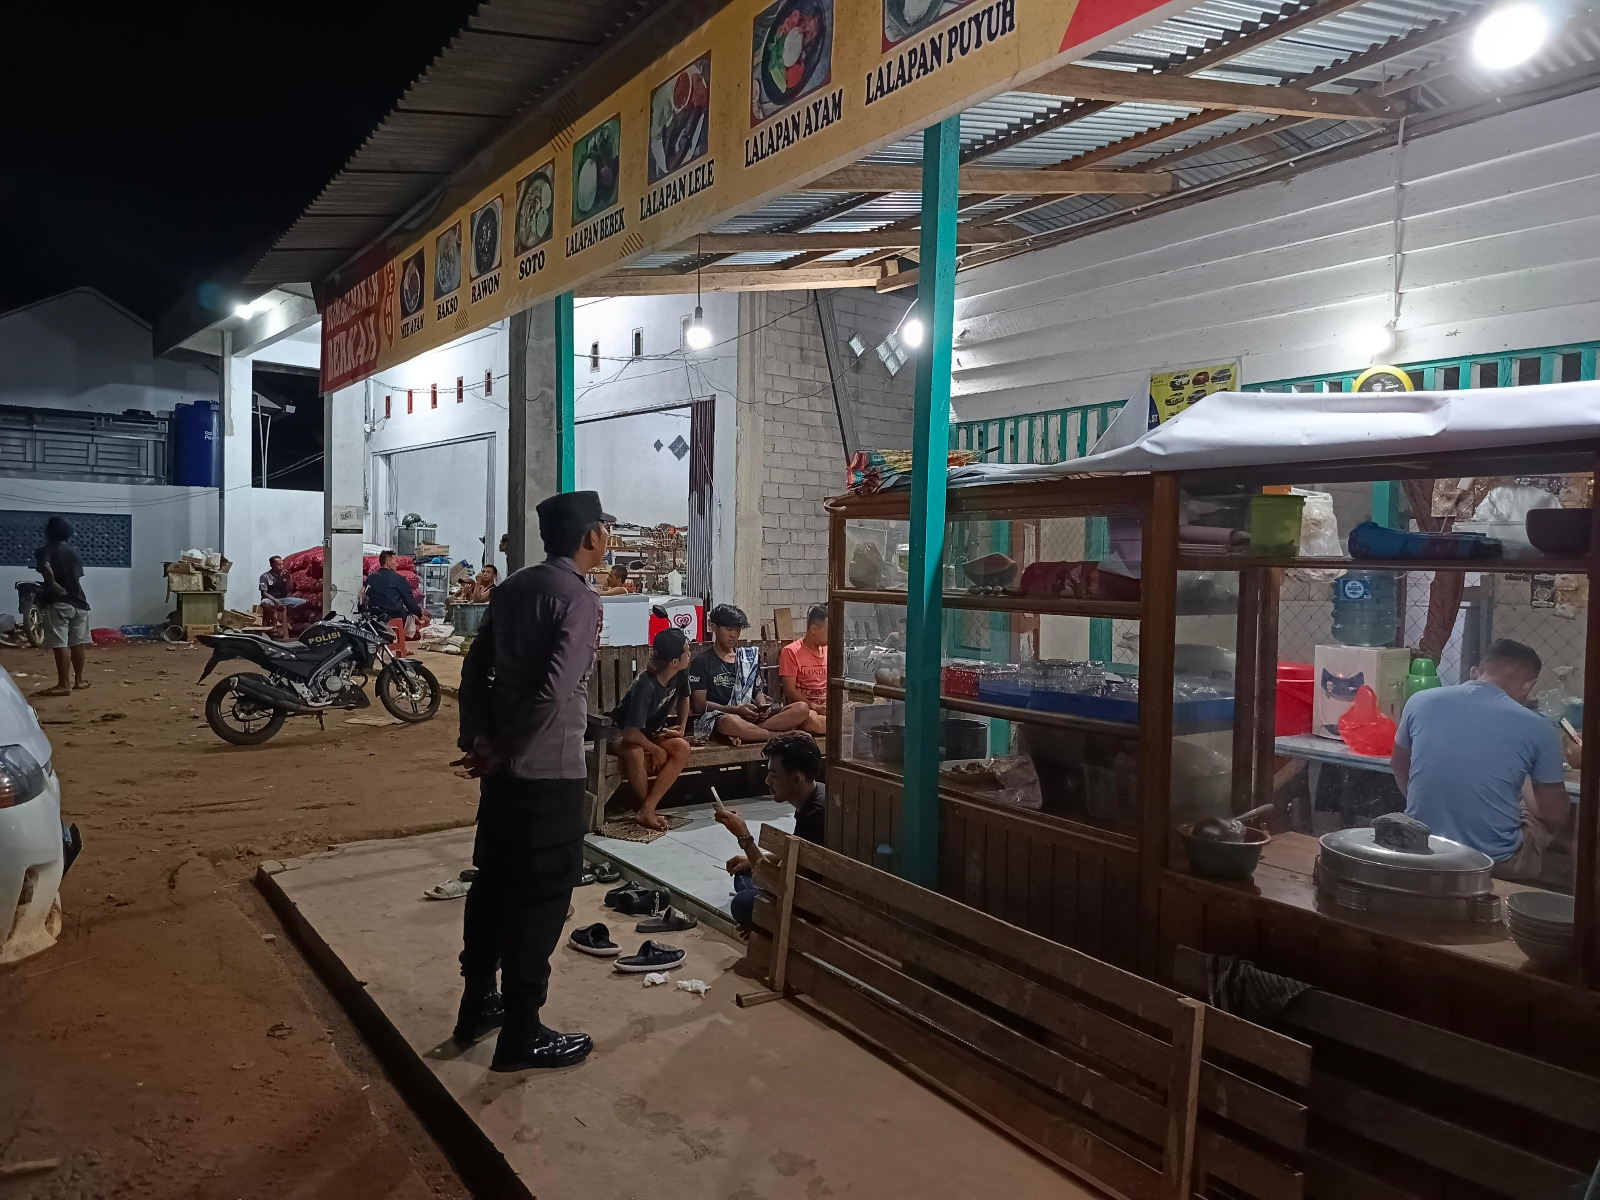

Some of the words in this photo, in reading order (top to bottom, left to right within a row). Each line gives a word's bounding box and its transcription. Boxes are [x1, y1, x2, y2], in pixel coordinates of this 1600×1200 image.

[864, 33, 944, 106] LALAPAN
[947, 0, 1016, 64] PUYUH
[744, 111, 801, 168] LALAPAN
[803, 88, 843, 138] AYAM
[639, 175, 687, 221] LALAPAN
[688, 158, 715, 197] LELE
[565, 220, 599, 258] LALAPAN
[599, 206, 625, 241] BEBEK
[518, 249, 546, 280] SOTO
[471, 272, 501, 304] RAWON
[436, 295, 459, 321] BAKSO
[400, 321, 410, 340] MIE
[326, 313, 378, 382] BERKAH
[308, 631, 341, 645] POLISI
[803, 668, 828, 677] LONDO
